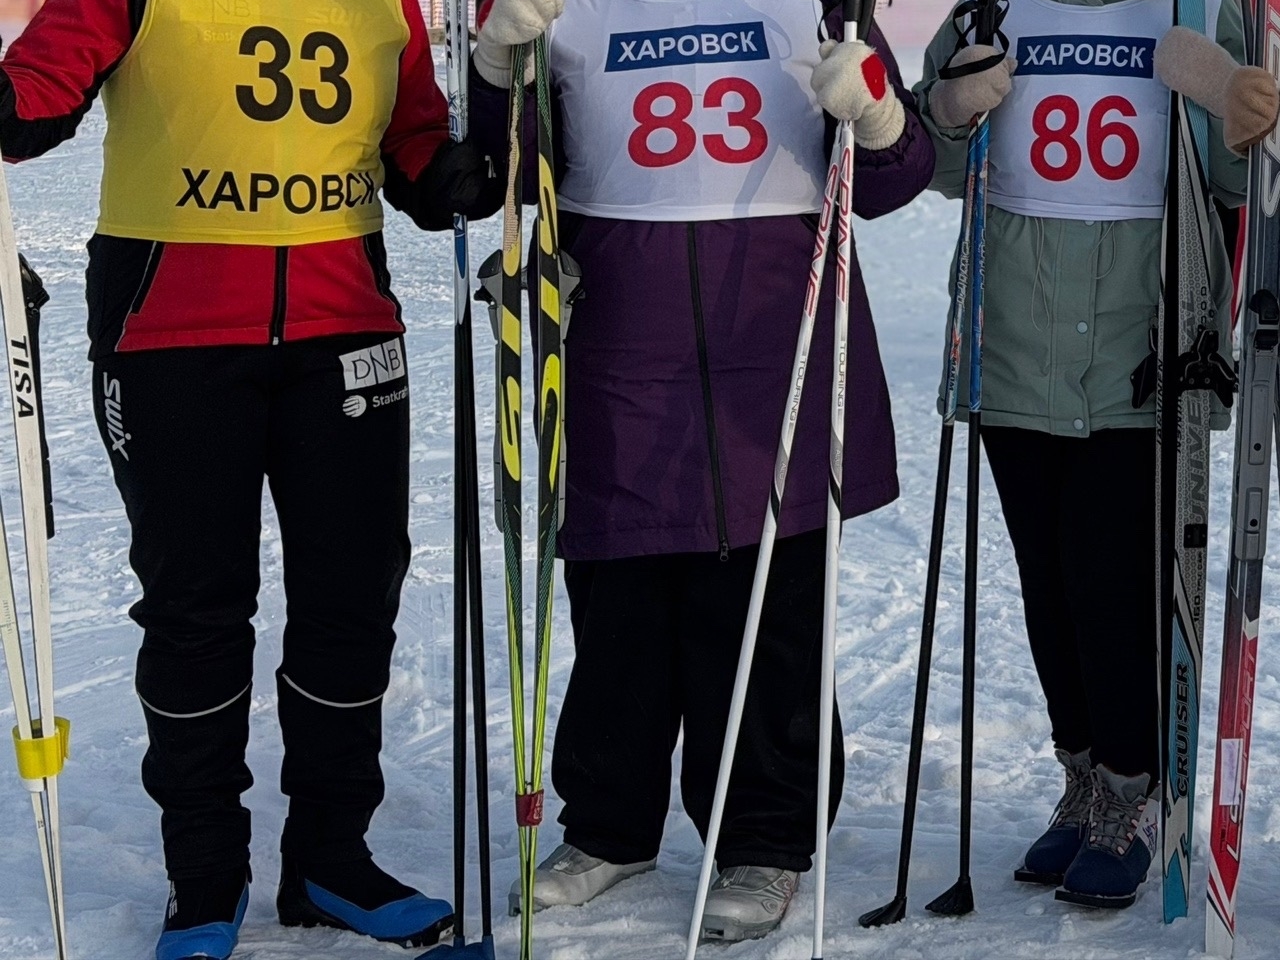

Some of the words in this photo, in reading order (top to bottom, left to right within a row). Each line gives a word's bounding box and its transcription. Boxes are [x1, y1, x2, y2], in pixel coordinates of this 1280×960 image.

[235, 25, 352, 125] 33
[617, 30, 758, 63] ХАРОВСК
[1023, 43, 1146, 68] ХАРОВСК
[627, 76, 769, 168] 83
[1030, 94, 1140, 182] 86
[11, 335, 35, 418] TISA
[351, 345, 401, 384] DNB
[789, 359, 807, 423] TOURING
[837, 343, 847, 407] TOURING
[1176, 661, 1189, 798] CRUISER
